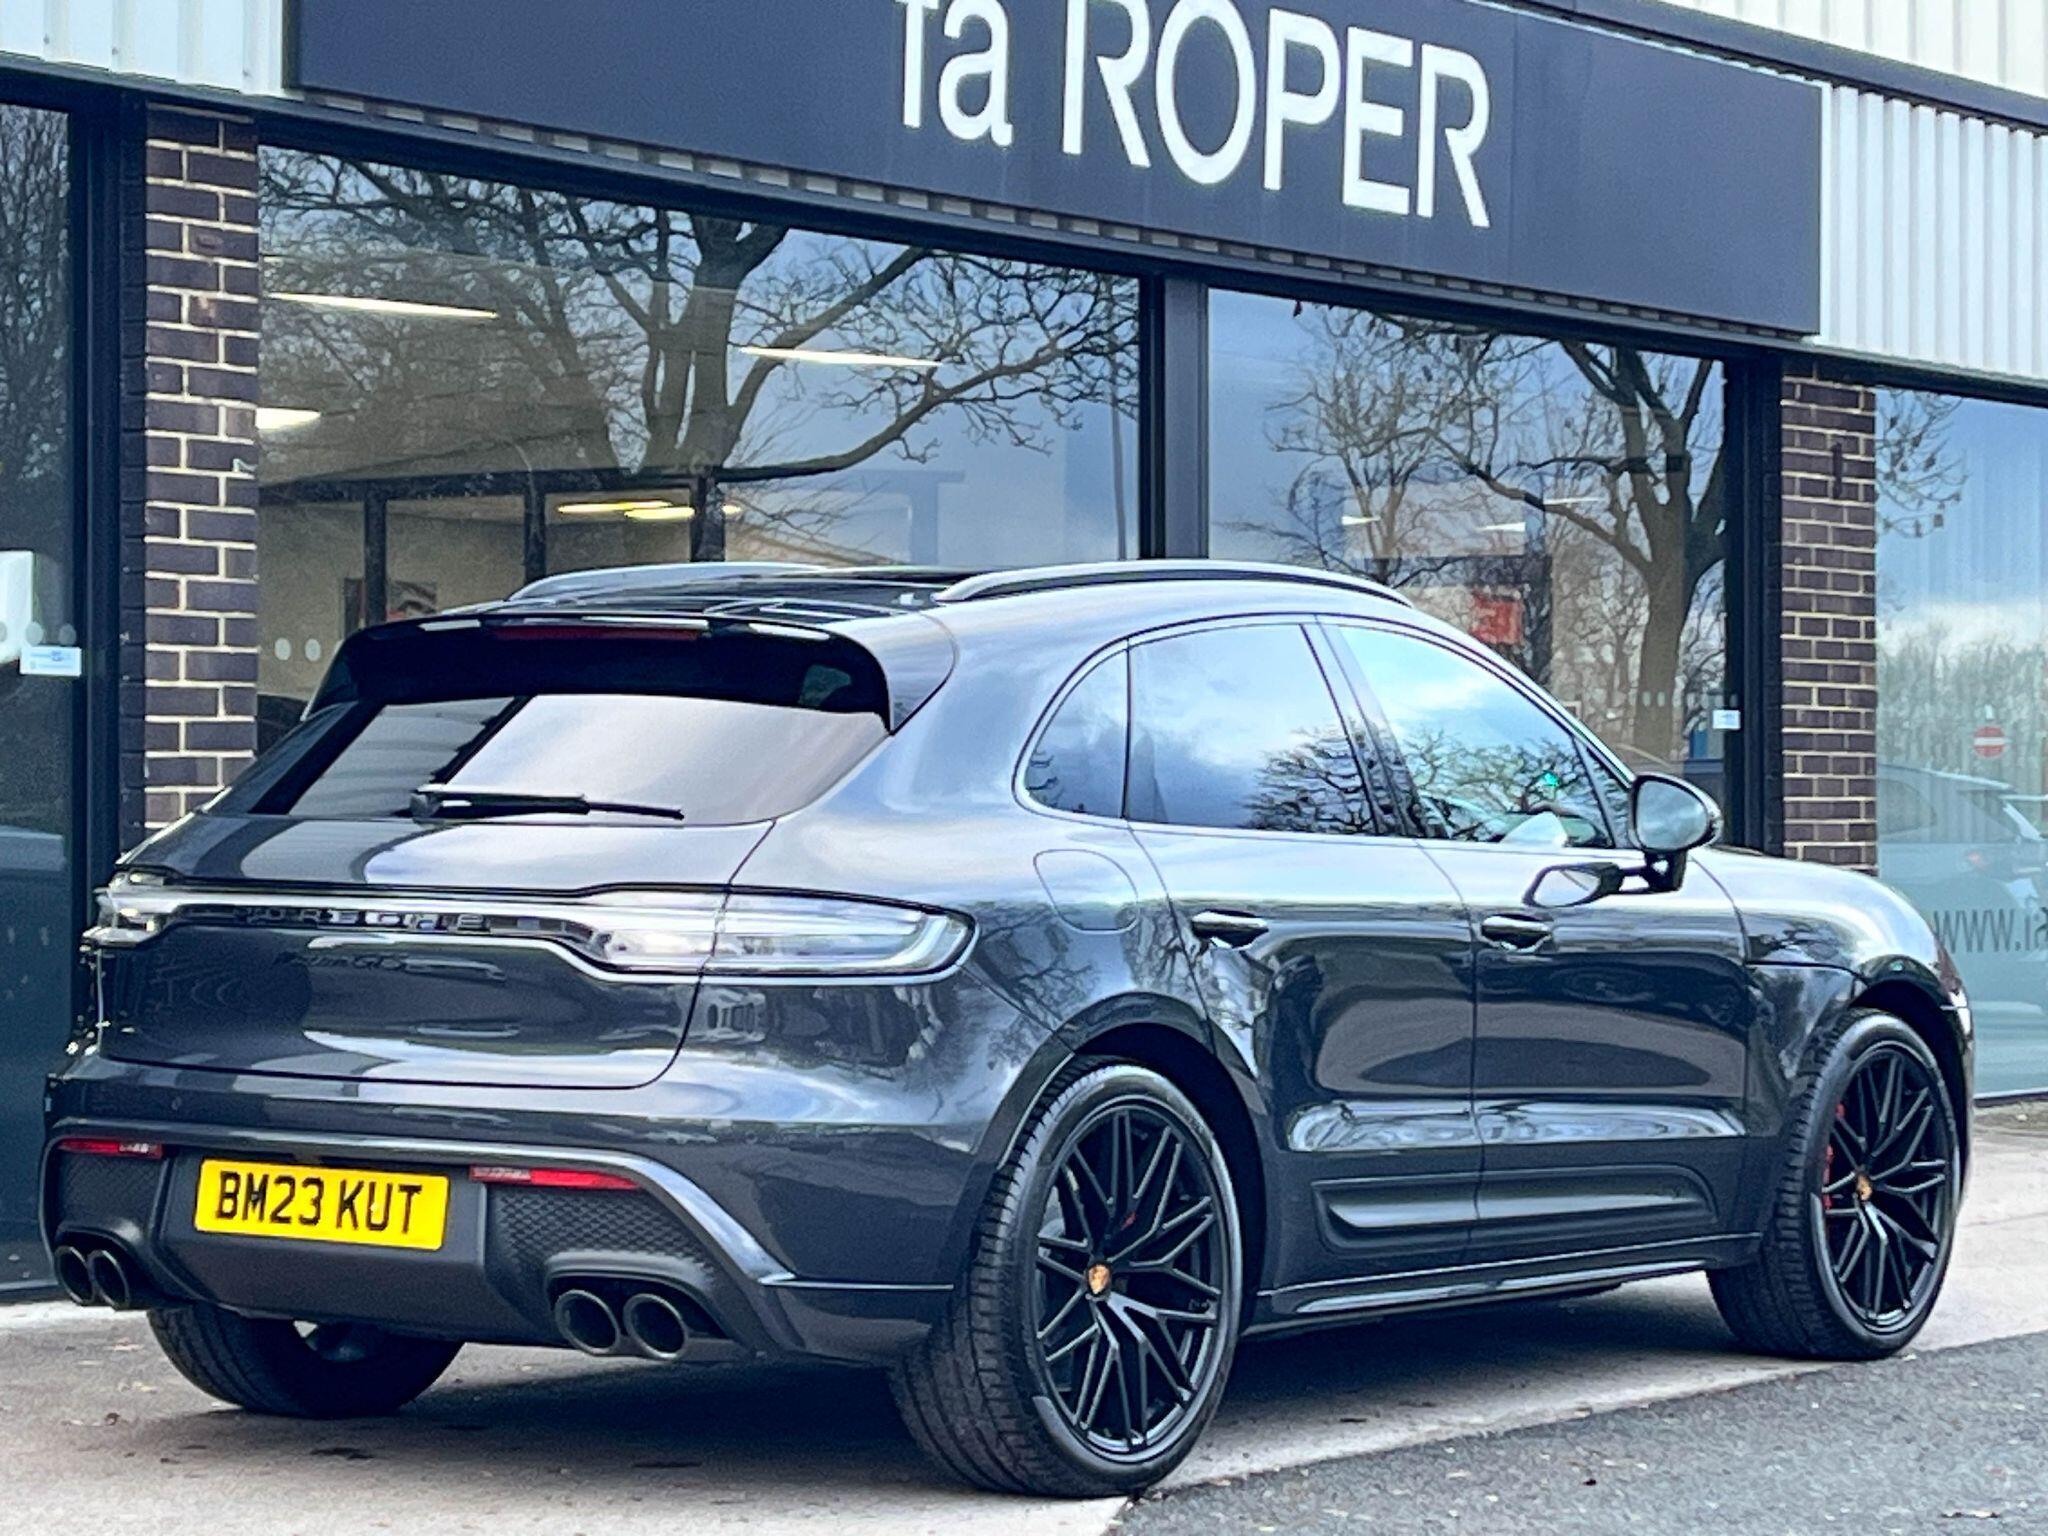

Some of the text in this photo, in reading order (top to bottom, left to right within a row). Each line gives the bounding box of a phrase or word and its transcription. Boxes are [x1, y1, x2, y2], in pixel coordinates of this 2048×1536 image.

[1062, 0, 1490, 228] ROPER
[216, 1170, 422, 1234] BM23 KUT
